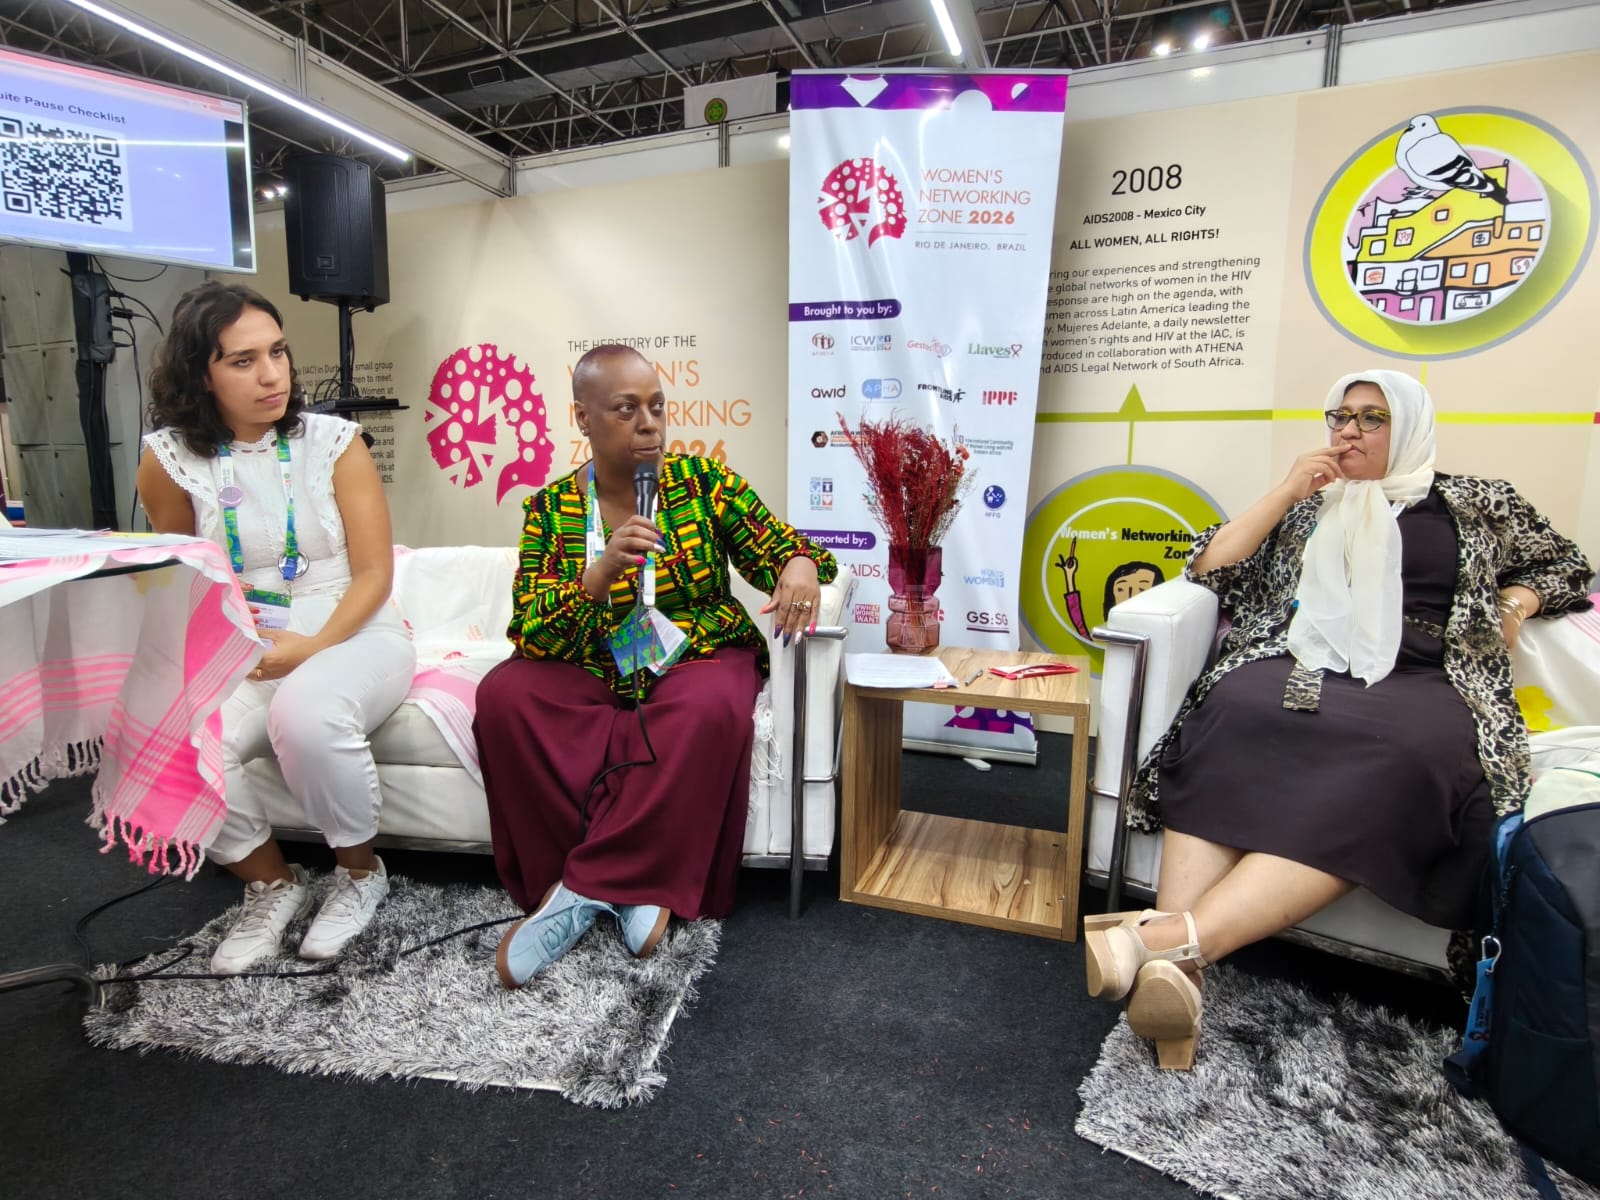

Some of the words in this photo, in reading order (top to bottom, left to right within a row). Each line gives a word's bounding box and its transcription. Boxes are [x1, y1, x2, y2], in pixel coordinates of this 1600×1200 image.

[24, 96, 64, 112] Pause
[68, 104, 126, 124] Checklist
[920, 168, 1004, 184] WOMEN'S
[1111, 164, 1182, 196] 2008
[919, 188, 1032, 205] NETWORKING
[917, 208, 964, 224] ZONE
[967, 210, 1016, 224] 2026
[1082, 211, 1134, 224] AIDS2008
[1144, 206, 1182, 220] Mexico
[1184, 204, 1206, 216] City
[915, 241, 930, 249] RIO
[996, 243, 1026, 251] BRAZIL
[1070, 240, 1091, 250] ALL
[1094, 236, 1142, 248] WOMEN,
[1144, 233, 1168, 244] ALL
[1170, 228, 1220, 242] RIGHTS!
[1072, 268, 1090, 278] our
[1092, 264, 1156, 276] experiences
[1158, 261, 1178, 271] and
[1182, 256, 1260, 270] strengthening
[1056, 282, 1087, 294] global
[1090, 279, 1138, 290] networks
[1141, 276, 1152, 287] of
[1154, 276, 1194, 286] women
[1197, 273, 1208, 283] in
[1210, 272, 1228, 282] the
[1232, 270, 1252, 281] HIV
[1091, 296, 1108, 304] are
[1112, 292, 1134, 304] high
[1136, 292, 1150, 301] on
[1154, 290, 1170, 300] the
[1173, 288, 1216, 300] agenda,
[1219, 286, 1244, 296] with
[804, 304, 841, 318] Brought
[844, 305, 854, 314] to
[856, 306, 874, 317] you
[877, 302, 892, 316] by:
[1074, 308, 1108, 318] across
[1112, 306, 1138, 316] Latin
[1140, 304, 1186, 314] America
[1188, 301, 1229, 312] leading
[1232, 300, 1250, 310] the
[1058, 323, 1098, 334] Mujeres
[1100, 320, 1150, 330] Adelante,
[1153, 320, 1160, 328] a
[1162, 317, 1189, 328] daily
[1191, 314, 1251, 326] newsletter
[568, 340, 589, 352] THE
[654, 336, 670, 348] OF
[674, 335, 697, 348] THE
[850, 336, 876, 346] ICW
[1050, 336, 1097, 346] women's
[1099, 334, 1130, 346] rights
[1132, 332, 1152, 342] and
[1155, 332, 1174, 342] HIV
[1176, 332, 1186, 340] at
[1190, 330, 1208, 340] the
[1210, 328, 1232, 339] IAC,
[1236, 328, 1245, 338] is
[968, 343, 1012, 356] Llaves
[1086, 350, 1094, 358] in
[1097, 346, 1166, 358] collaboration
[1170, 344, 1192, 355] with
[1195, 342, 1244, 353] ATHENA
[1054, 363, 1078, 374] AIDS
[1081, 362, 1110, 374] Legal
[1112, 361, 1158, 371] Network
[1161, 359, 1172, 369] of
[1174, 358, 1206, 368] South
[1208, 356, 1244, 367] Africa.
[811, 384, 846, 398] awid
[669, 440, 727, 465] 026
[852, 533, 868, 547] by:
[1060, 526, 1118, 540] Women's
[1122, 528, 1194, 543] Networkin
[848, 563, 880, 578] AIDS
